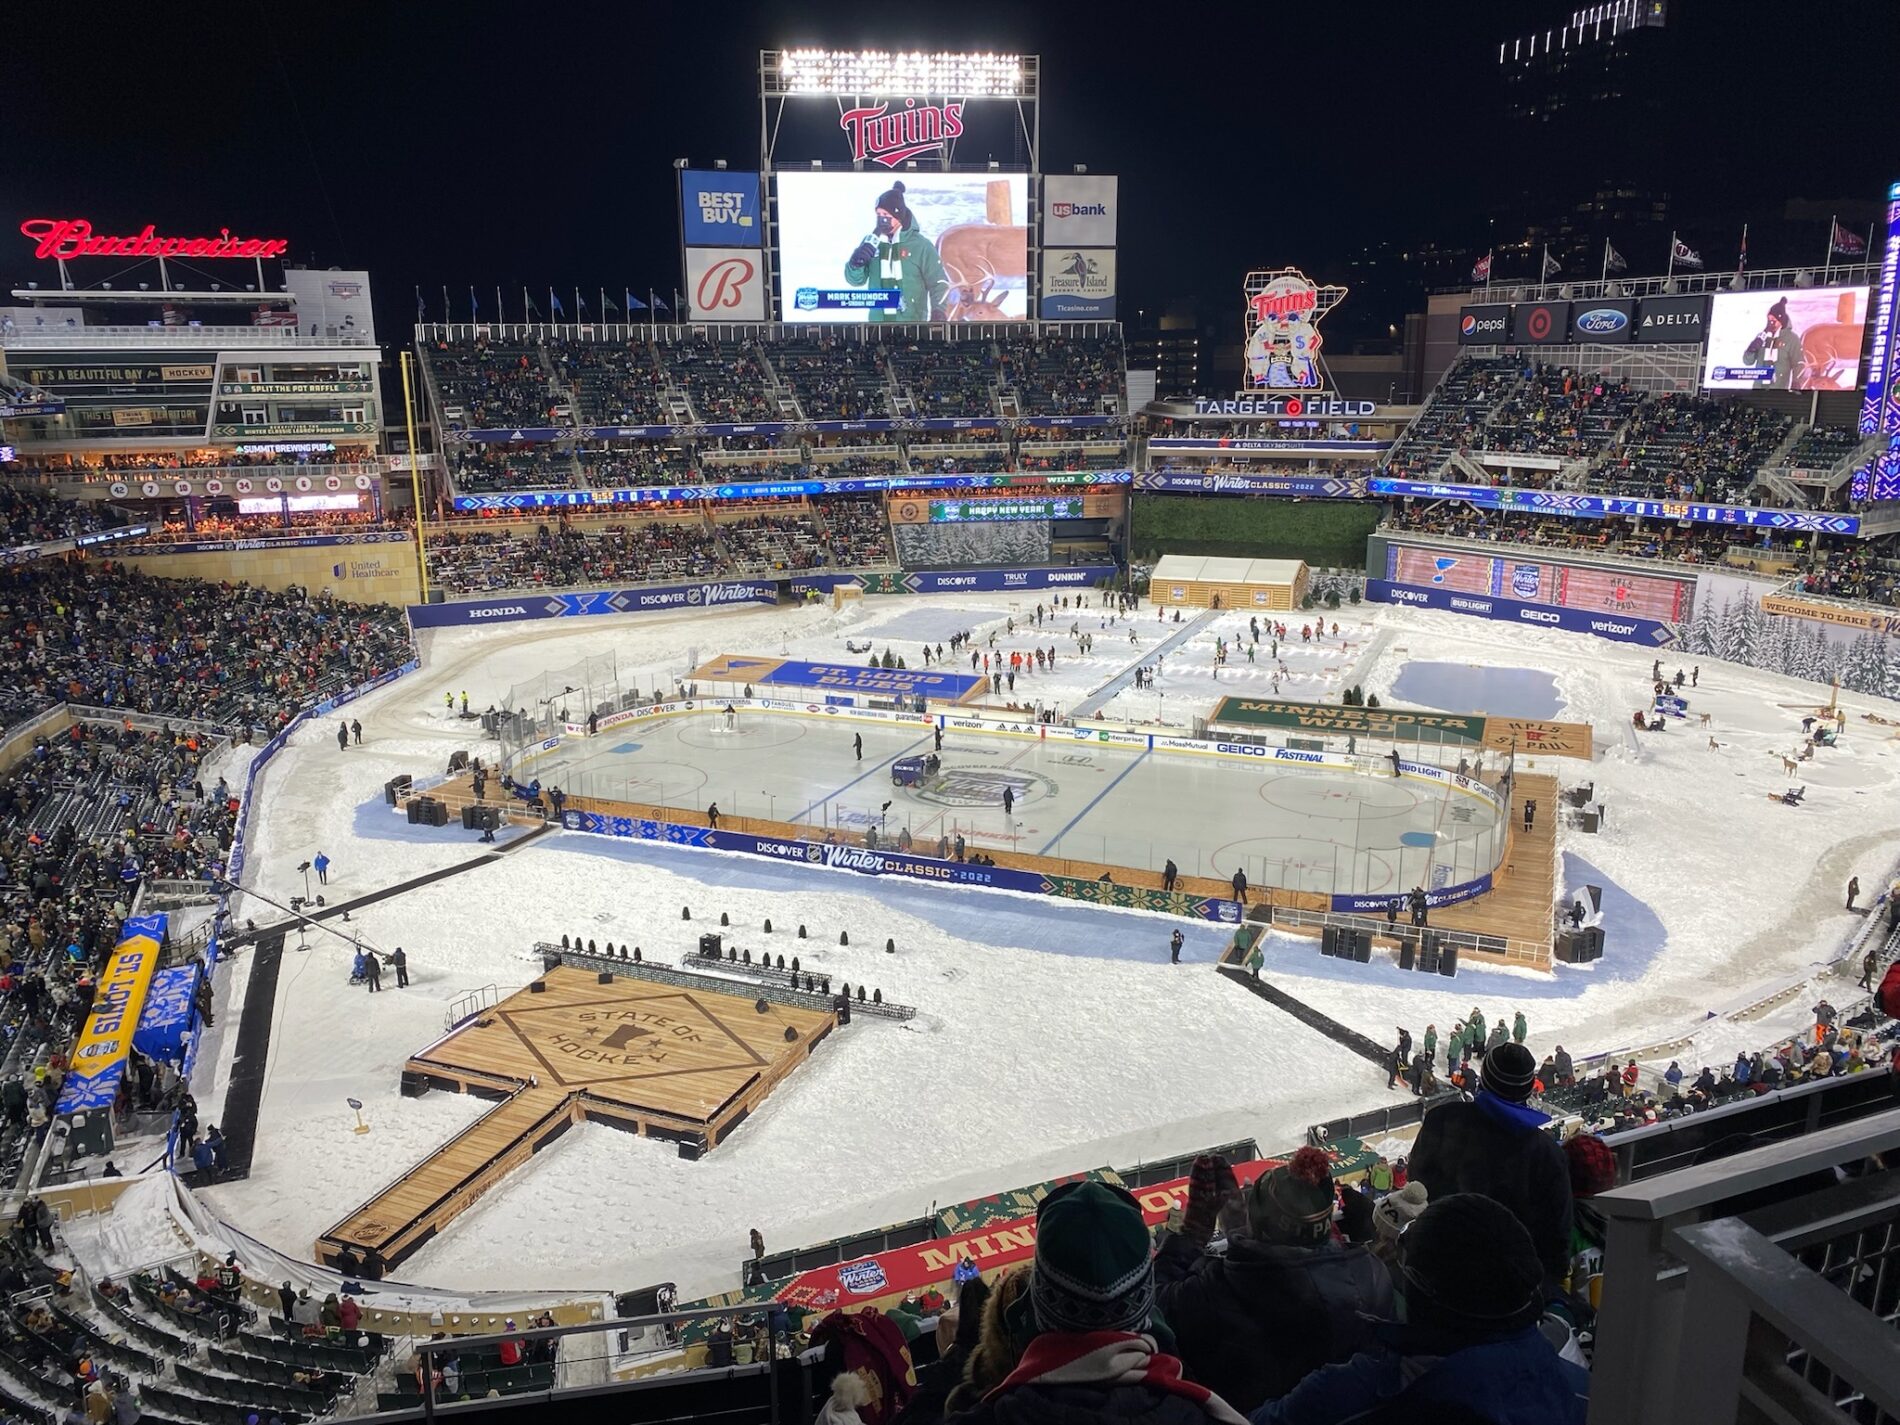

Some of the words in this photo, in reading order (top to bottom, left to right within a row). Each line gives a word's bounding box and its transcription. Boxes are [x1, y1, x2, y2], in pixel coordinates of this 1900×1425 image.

[840, 98, 964, 168] Twins
[698, 192, 744, 208] BEST
[703, 209, 741, 224] BUY
[21, 219, 287, 259] Budweiser
[698, 259, 753, 311] B
[1050, 276, 1079, 287] Treasure
[1086, 276, 1108, 287] Island
[827, 293, 850, 301] MARK
[1251, 288, 1317, 325] Twins
[1477, 318, 1506, 332] pepsi
[1586, 314, 1616, 330] Ford
[1656, 313, 1700, 325] DELTA
[58, 370, 65, 380] A
[67, 369, 122, 381] BEAUTIFUL
[125, 369, 142, 380] DAY
[1196, 401, 1286, 415] TARGET
[1307, 402, 1375, 416] FIELD
[244, 445, 274, 453] SUMMIT
[276, 444, 310, 452] BREWING
[312, 444, 328, 452] PUB
[239, 482, 250, 490] 34
[360, 478, 366, 486] 3
[1172, 478, 1201, 486] DISCOVER
[1214, 475, 1251, 490] Winter
[592, 492, 614, 500] 9:55
[969, 506, 998, 515] HAPPY
[1000, 506, 1018, 514] NEW
[1019, 505, 1044, 513] YEAR!
[1498, 503, 1530, 512] TREASURE
[1533, 506, 1556, 514] ISLAND
[1560, 508, 1576, 516] COVE
[1662, 504, 1688, 514] 9:55
[234, 540, 266, 550] Winter
[351, 561, 381, 570] United
[351, 569, 400, 578] Healthcare
[1048, 572, 1086, 582] DUNKIN'
[938, 577, 977, 586] DISCOVER
[641, 593, 685, 605] DISCOVER
[702, 584, 755, 606] Winter
[1391, 589, 1428, 603] DISCOVER
[469, 606, 526, 618] HONDA
[1452, 600, 1467, 608] BUD
[1468, 602, 1490, 611] LIGHT
[1520, 608, 1560, 624] GEICO
[1766, 602, 1818, 618] WELCOME
[1820, 612, 1834, 620] TO
[1837, 614, 1868, 626] LAKE
[1590, 621, 1632, 636] verizon
[808, 666, 847, 676] ST.
[857, 671, 944, 684] LOUIS
[817, 676, 914, 690] BLUES
[637, 704, 676, 718] DISCOVER
[895, 713, 922, 722] guaranteed
[1237, 701, 1469, 730] MINNESOTA
[604, 712, 634, 726] HONDA
[952, 720, 983, 728] verizon
[1300, 716, 1396, 733] WILD
[1075, 730, 1088, 738] SAP
[1168, 740, 1208, 750] MassMutual
[1216, 743, 1266, 756] GEICO
[1526, 740, 1574, 752] PAUL
[1275, 748, 1324, 763] FASTENAL
[1398, 763, 1416, 772] BUD
[1418, 766, 1442, 779] LIGHT
[1455, 775, 1470, 786] SN
[1474, 782, 1490, 800] Great
[756, 842, 804, 858] DISCOVER
[824, 844, 885, 872] Winter
[885, 860, 951, 879] CLASSIC
[960, 871, 991, 882] 2022
[1354, 900, 1388, 910] DISCOVER
[114, 952, 144, 978] ST.
[93, 980, 135, 1036] LOUIS
[578, 1011, 675, 1028] STATE
[672, 1026, 702, 1042] OF
[548, 1033, 668, 1065] HOCKEY
[838, 1268, 884, 1287] Winter
